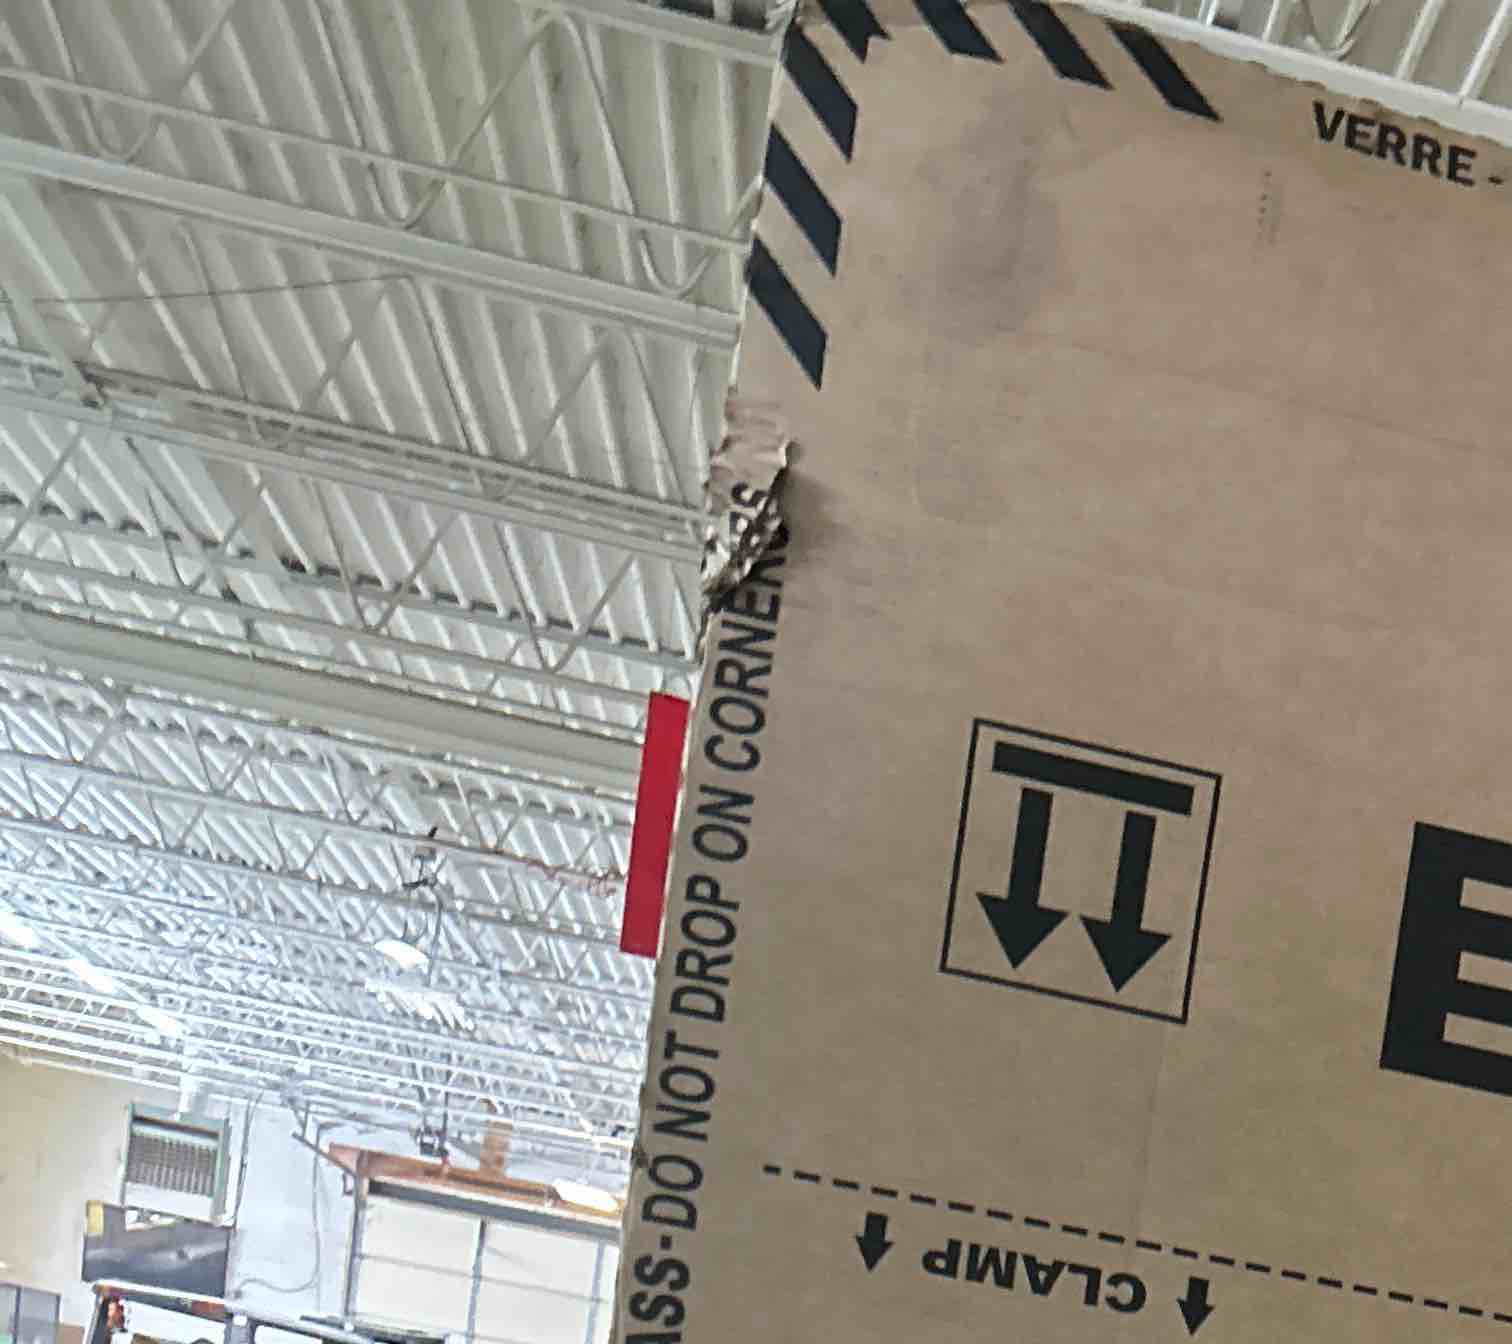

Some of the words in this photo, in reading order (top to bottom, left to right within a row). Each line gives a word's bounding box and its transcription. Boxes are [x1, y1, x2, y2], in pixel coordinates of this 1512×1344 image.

[1314, 102, 1476, 187] VERRE
[692, 786, 755, 864] ON
[670, 875, 740, 1024] DROP
[654, 1031, 721, 1142] NOT
[921, 1238, 1147, 1314] CLAMP
